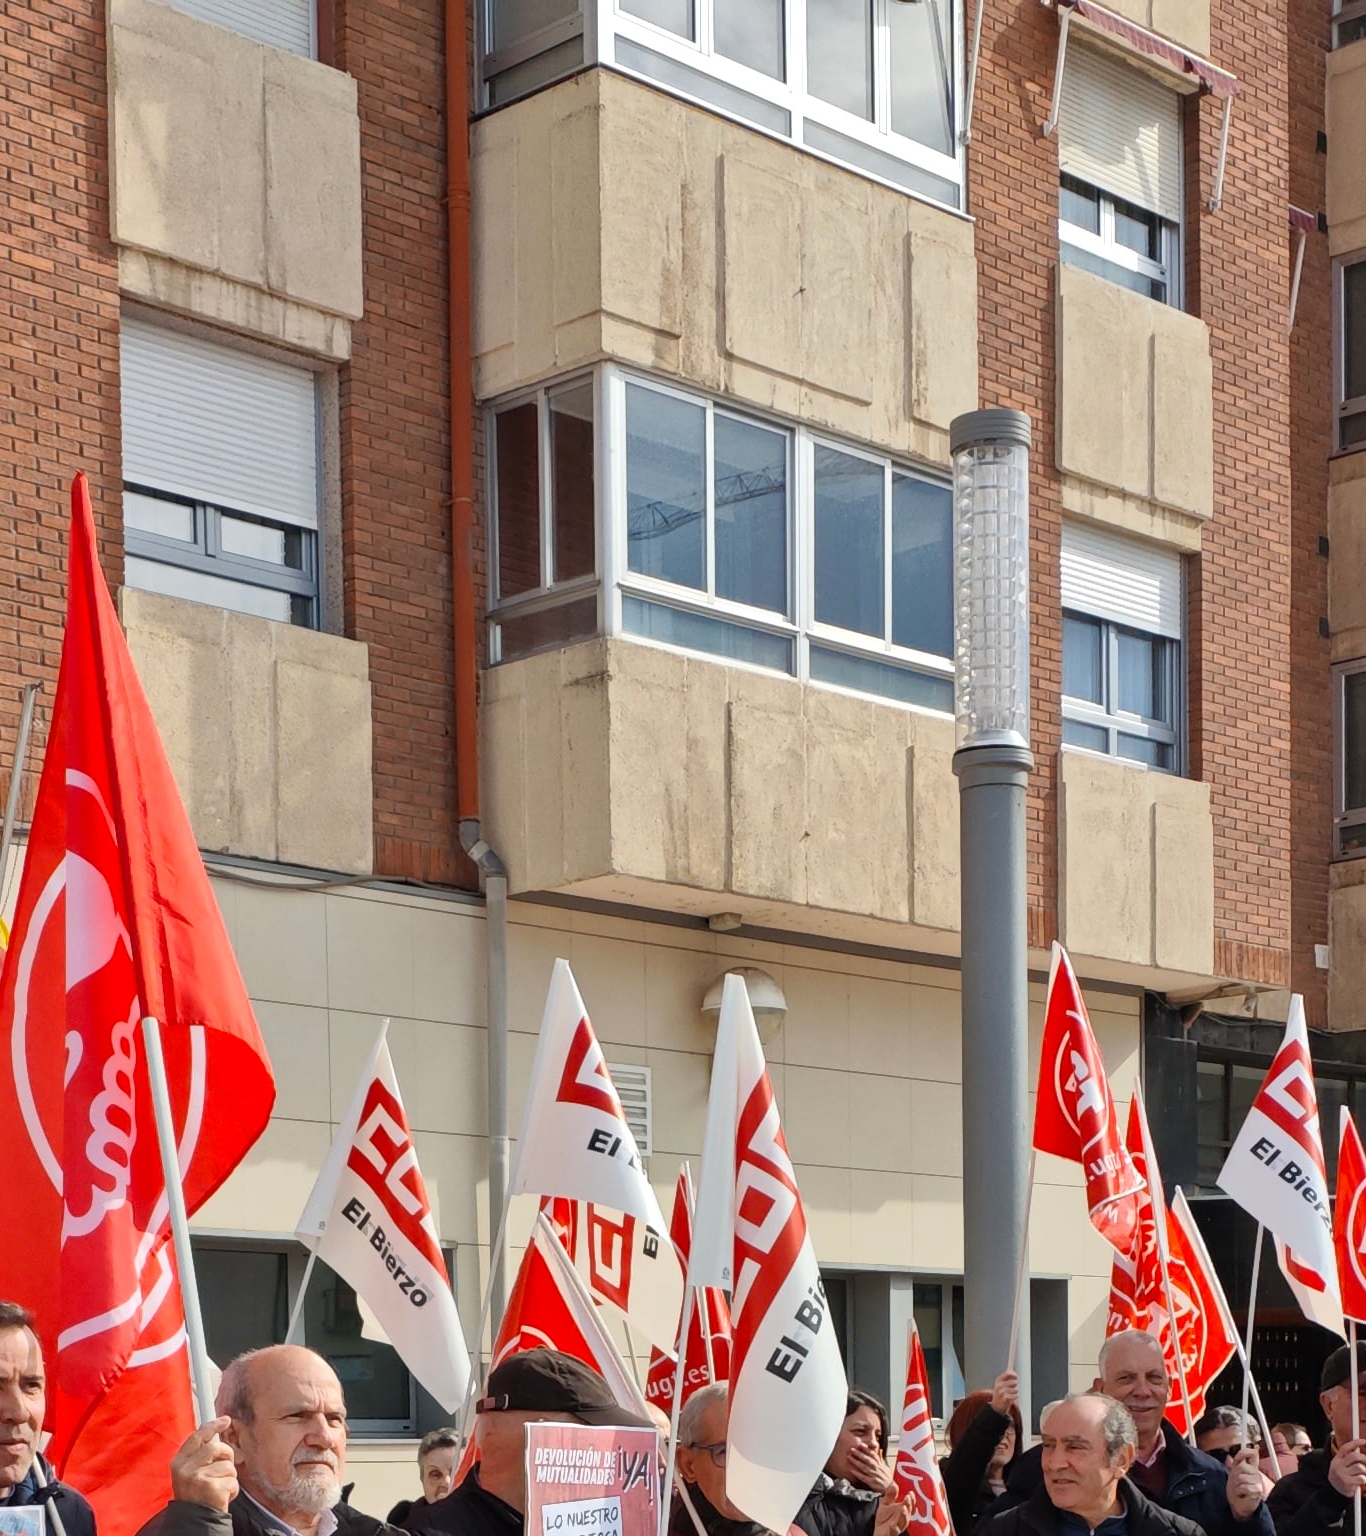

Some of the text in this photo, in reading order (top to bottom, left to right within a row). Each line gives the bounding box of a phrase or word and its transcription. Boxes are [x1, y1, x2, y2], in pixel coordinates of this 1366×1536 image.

[587, 1128, 622, 1157] El
[1250, 1137, 1280, 1167] El
[341, 1197, 428, 1307] El Bierzo
[765, 1335, 809, 1384] El
[535, 1446, 602, 1467] DEVOLUCIÓN
[604, 1453, 616, 1469] DE
[536, 1465, 615, 1486] MUTUALIDADES
[546, 1505, 619, 1531] LO NUESTRO
